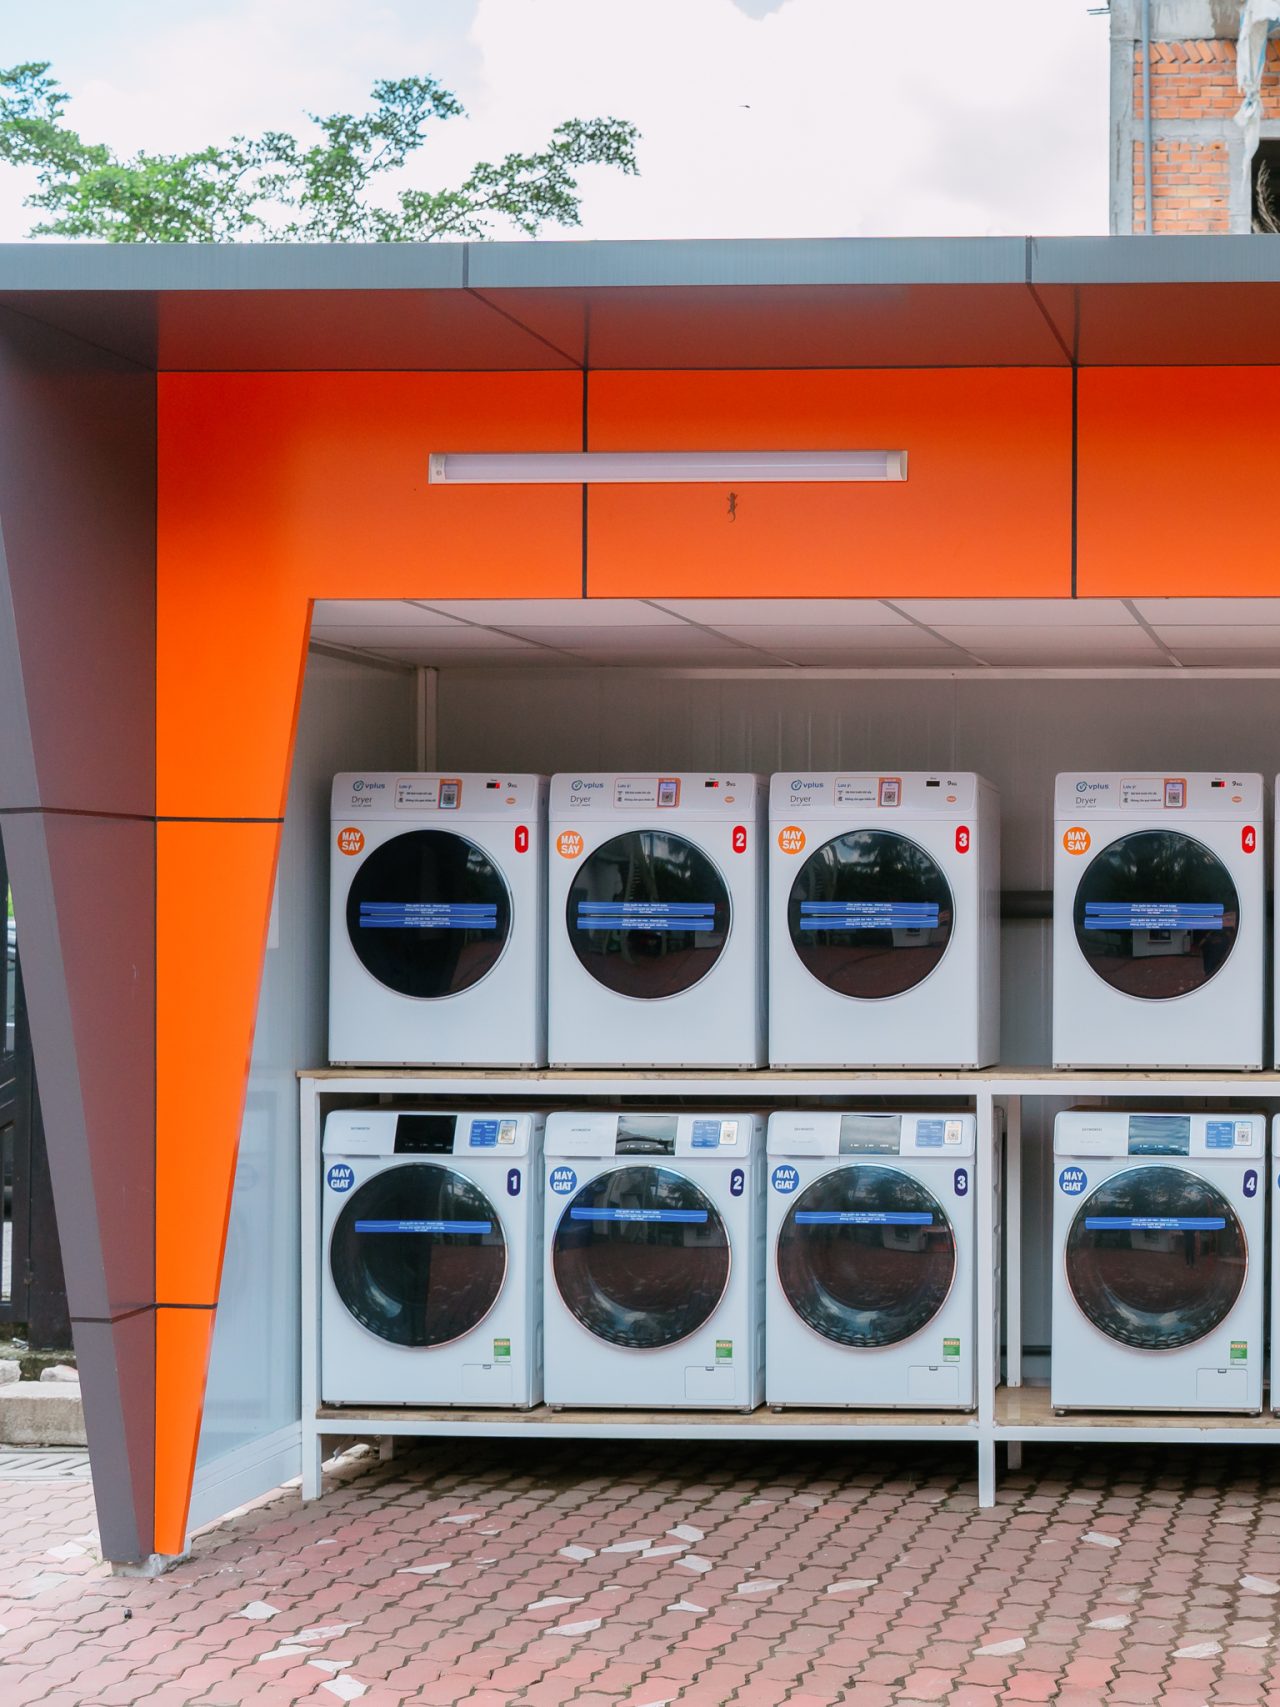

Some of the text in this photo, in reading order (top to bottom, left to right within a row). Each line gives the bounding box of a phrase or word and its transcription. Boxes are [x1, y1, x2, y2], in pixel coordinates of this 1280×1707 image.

[352, 796, 371, 804] Dryer
[571, 796, 590, 804] Dryer
[791, 796, 810, 804] Dryer
[1076, 797, 1096, 805] Dryer
[519, 833, 525, 846] 1
[736, 833, 744, 846] 2
[959, 833, 967, 846] 3
[1245, 833, 1253, 846] 4
[511, 1176, 517, 1189] 1
[733, 1176, 742, 1189] 2
[958, 1176, 966, 1189] 3
[1246, 1177, 1255, 1190] 4
